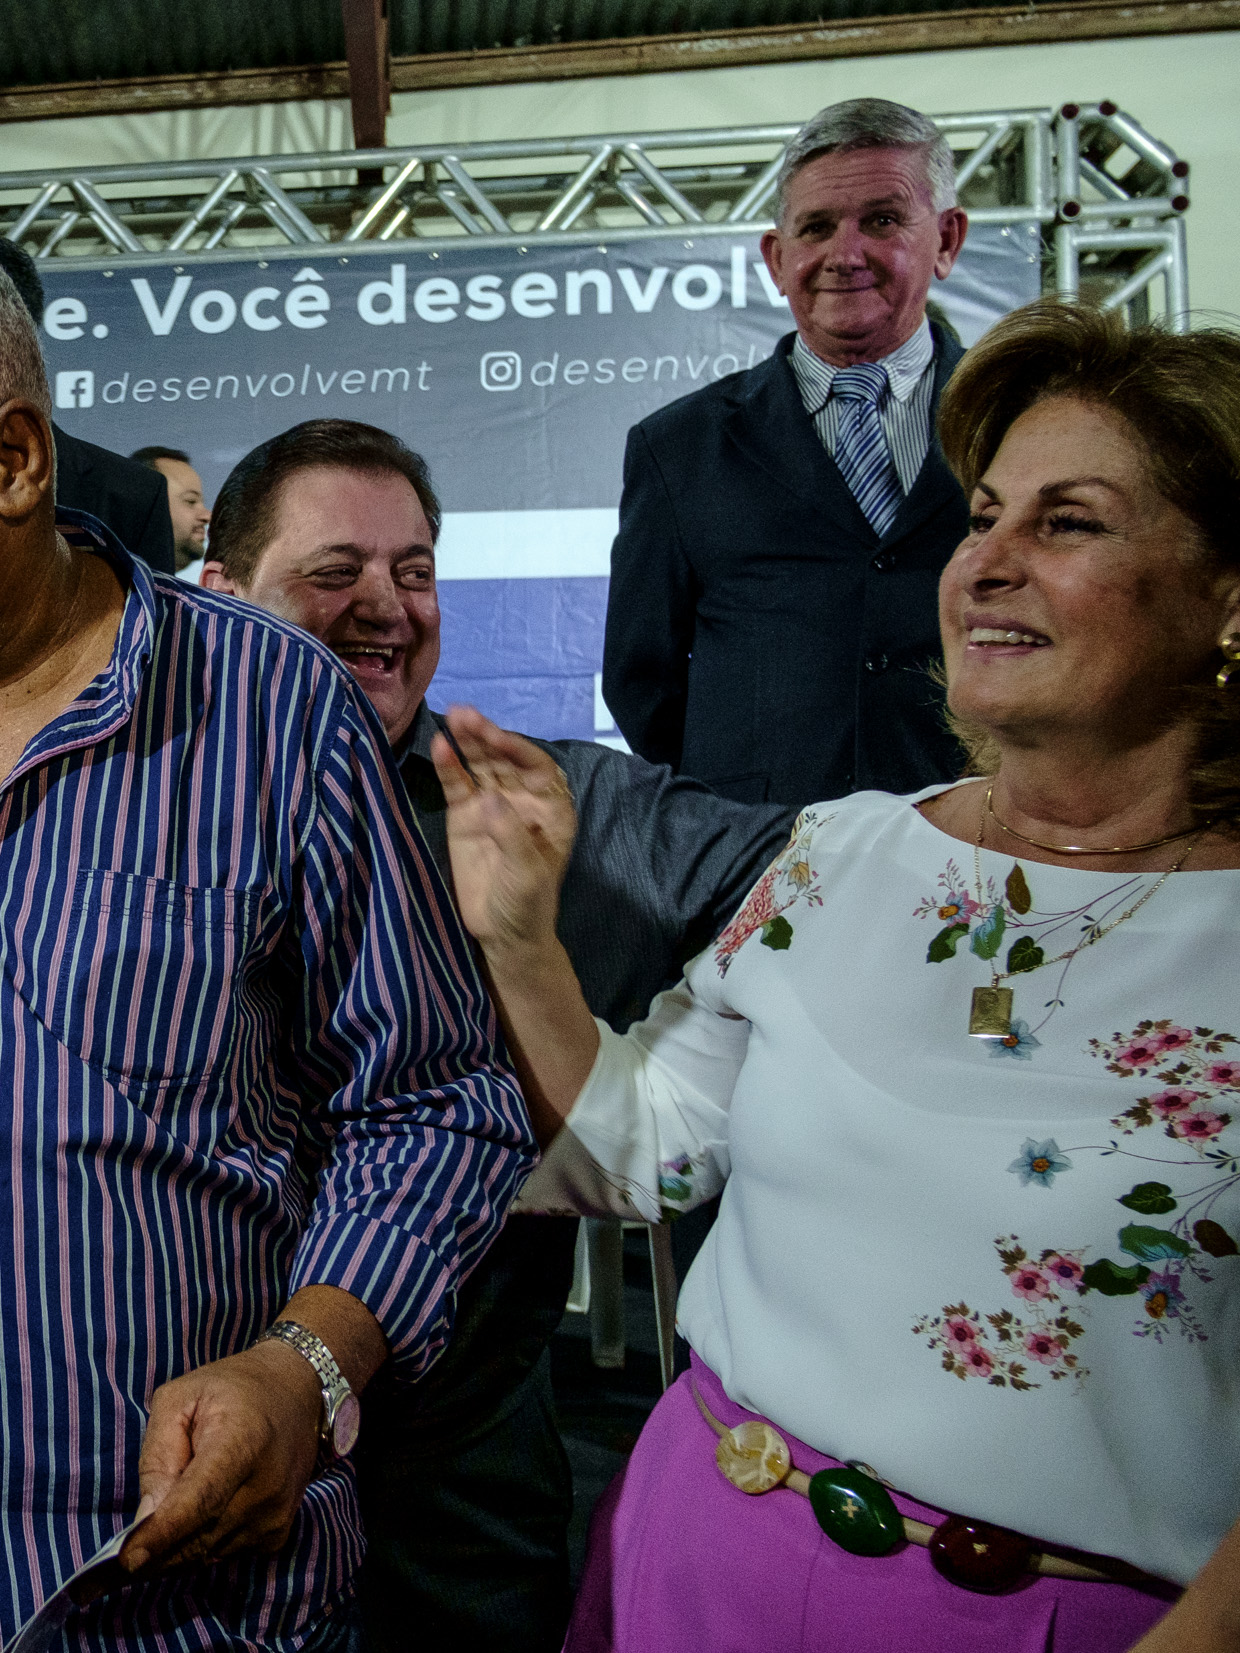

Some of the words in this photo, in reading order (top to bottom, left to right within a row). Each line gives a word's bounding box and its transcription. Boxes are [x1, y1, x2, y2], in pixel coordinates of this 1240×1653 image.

[131, 267, 331, 336] Você
[102, 361, 433, 404] desenvolvemt
[530, 344, 766, 387] desenvol
